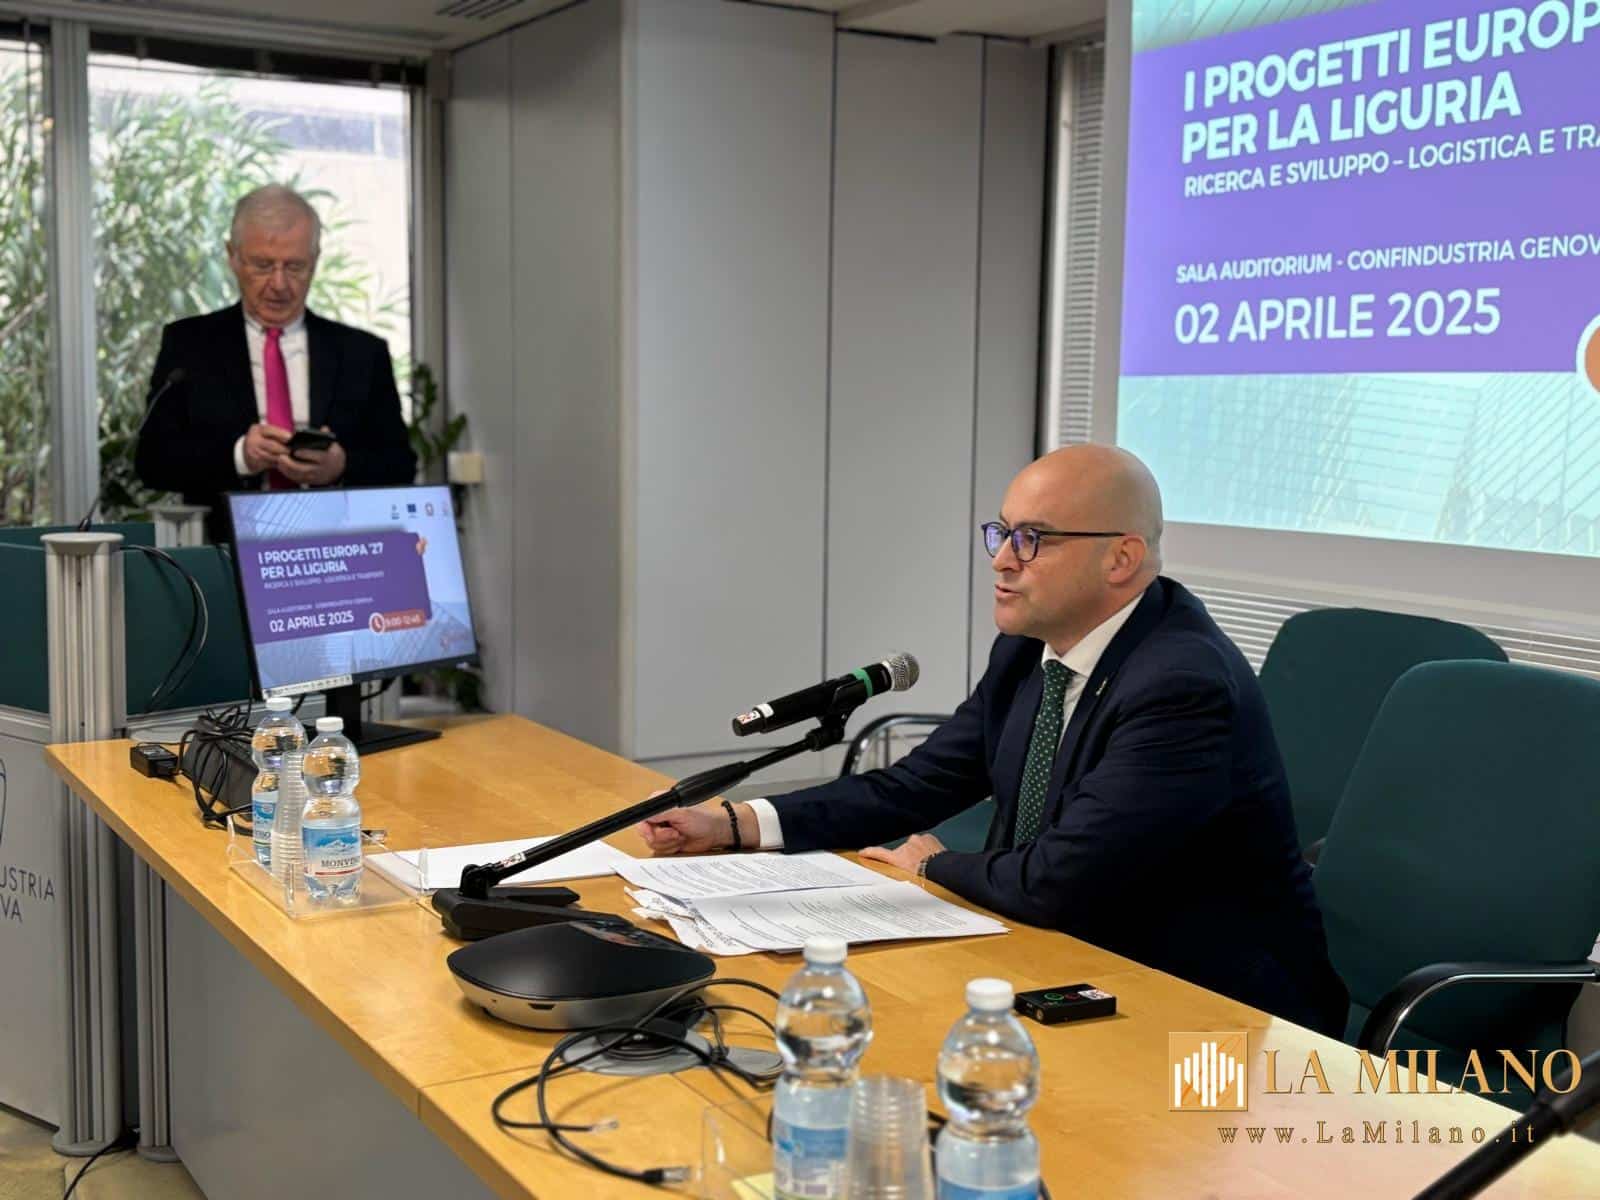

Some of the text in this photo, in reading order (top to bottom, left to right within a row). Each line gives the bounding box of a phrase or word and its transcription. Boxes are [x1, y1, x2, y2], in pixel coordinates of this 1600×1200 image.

[1183, 70, 1196, 112] I
[1203, 27, 1411, 109] PROGETTI
[1181, 70, 1522, 164] PER LA LIGURIA
[1184, 167, 1266, 198] RICERCA
[1269, 164, 1283, 187] E
[1285, 150, 1390, 185] SVILUPPO
[1408, 132, 1533, 170] LOGISTICA
[1539, 128, 1555, 154] E
[1561, 123, 1600, 151] TR
[1175, 262, 1218, 284] SALA
[1219, 252, 1333, 281] AUDITORIUM
[1347, 239, 1516, 271] CONFINDUSTRIA
[1174, 287, 1501, 345] 02 APRILE 2025
[260, 565, 285, 580] PER
[286, 564, 302, 577] LA
[303, 560, 348, 576] LIGURIA
[263, 547, 321, 565] PROGETTI
[321, 543, 368, 559] EUROPA
[269, 610, 354, 633] 02 APRILE 2025
